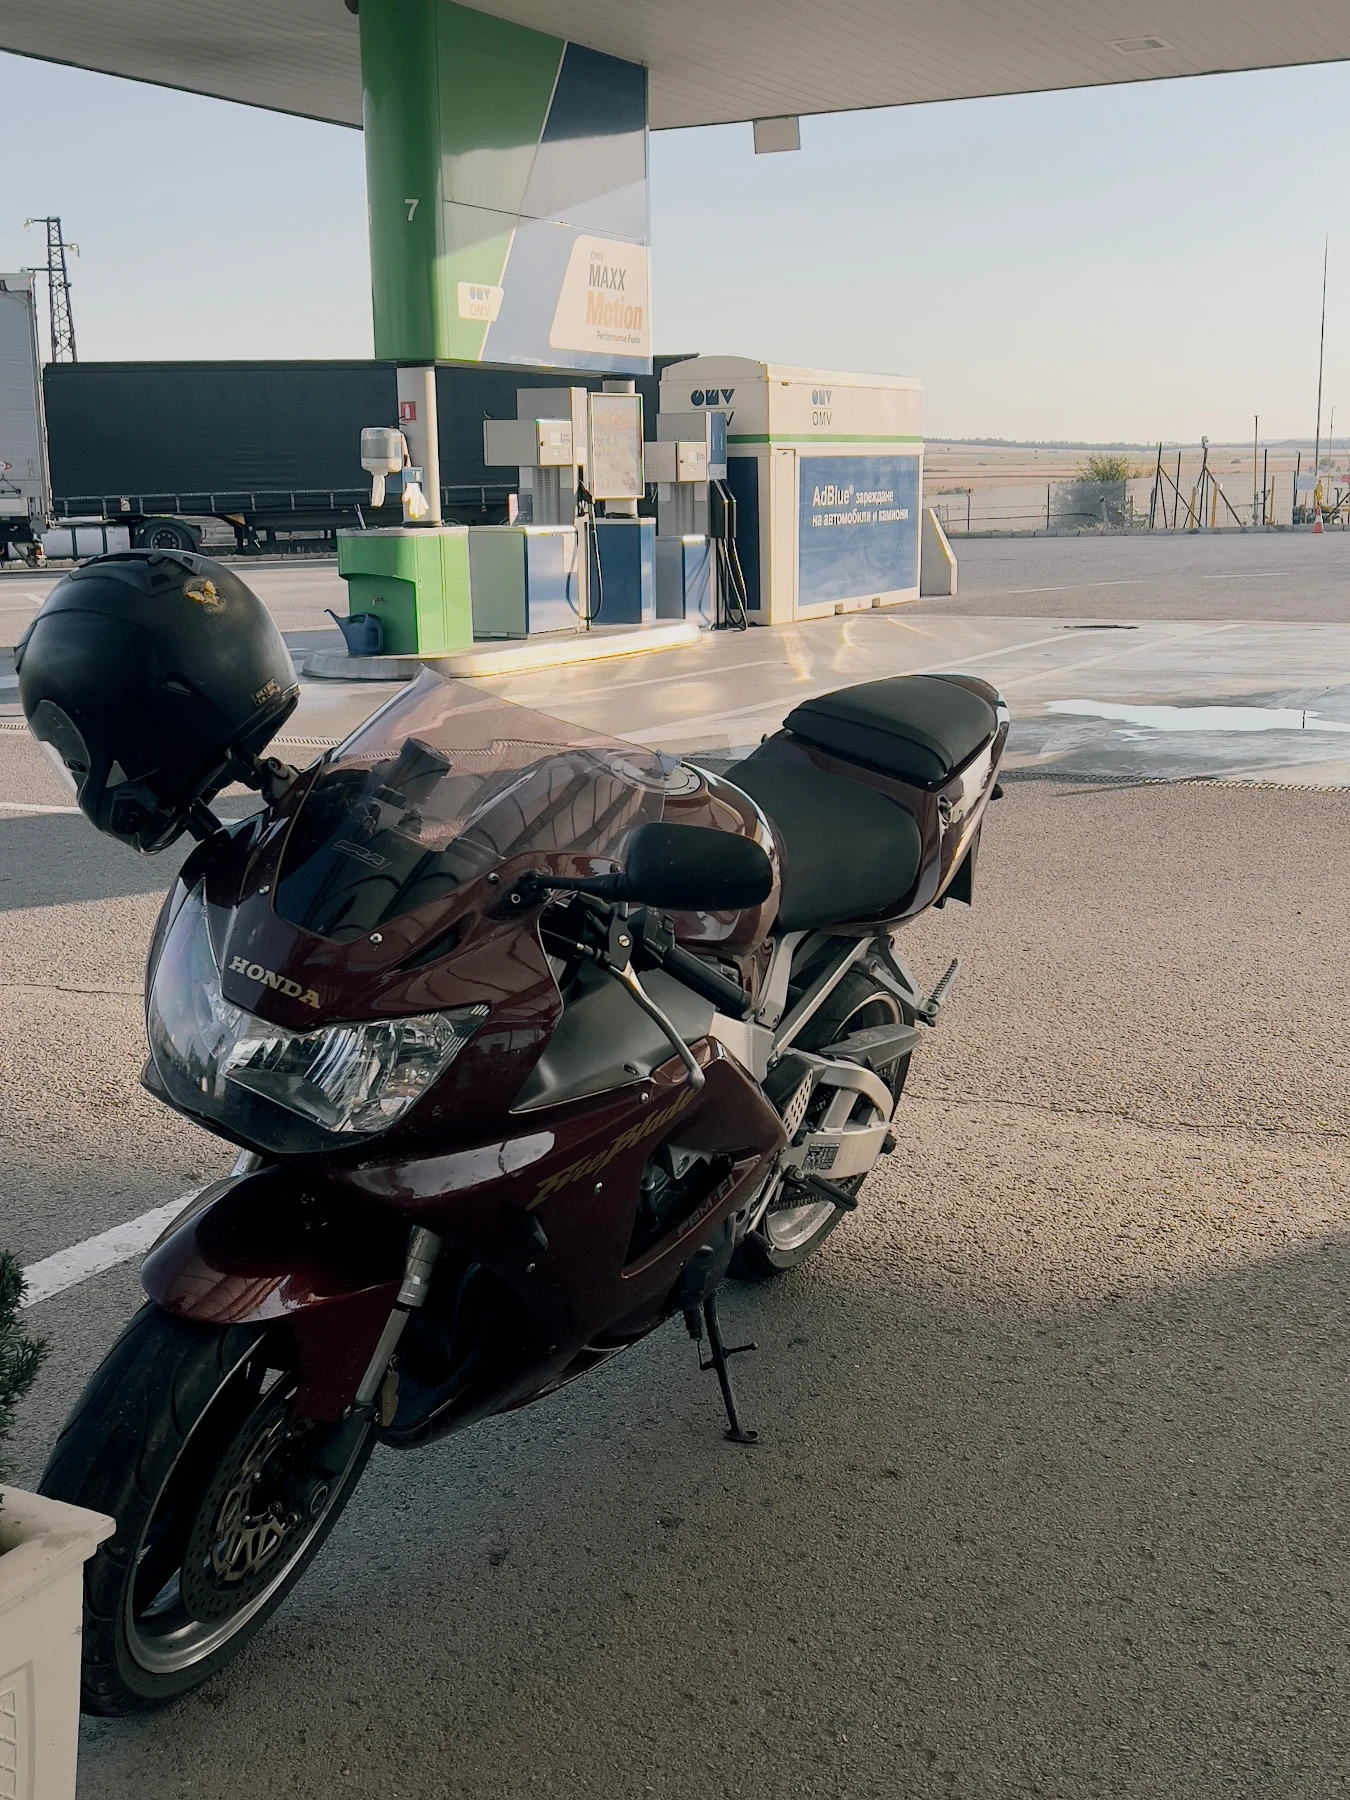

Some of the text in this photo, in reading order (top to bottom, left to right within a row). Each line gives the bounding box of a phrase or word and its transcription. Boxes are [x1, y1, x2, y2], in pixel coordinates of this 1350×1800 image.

[404, 198, 419, 221] 7
[588, 263, 626, 292] MAXX
[469, 286, 490, 301] OMV
[470, 303, 491, 317] OMV
[585, 290, 643, 330] Motion
[596, 331, 640, 344] Performance Fuels
[690, 388, 735, 406] OMV
[812, 389, 832, 405] OMV
[812, 411, 832, 426] OMV
[855, 490, 894, 507] зареждане
[812, 508, 909, 527] на автомобили и камиони
[228, 955, 320, 1009] HONDA
[677, 1173, 736, 1237] PGM-FI
